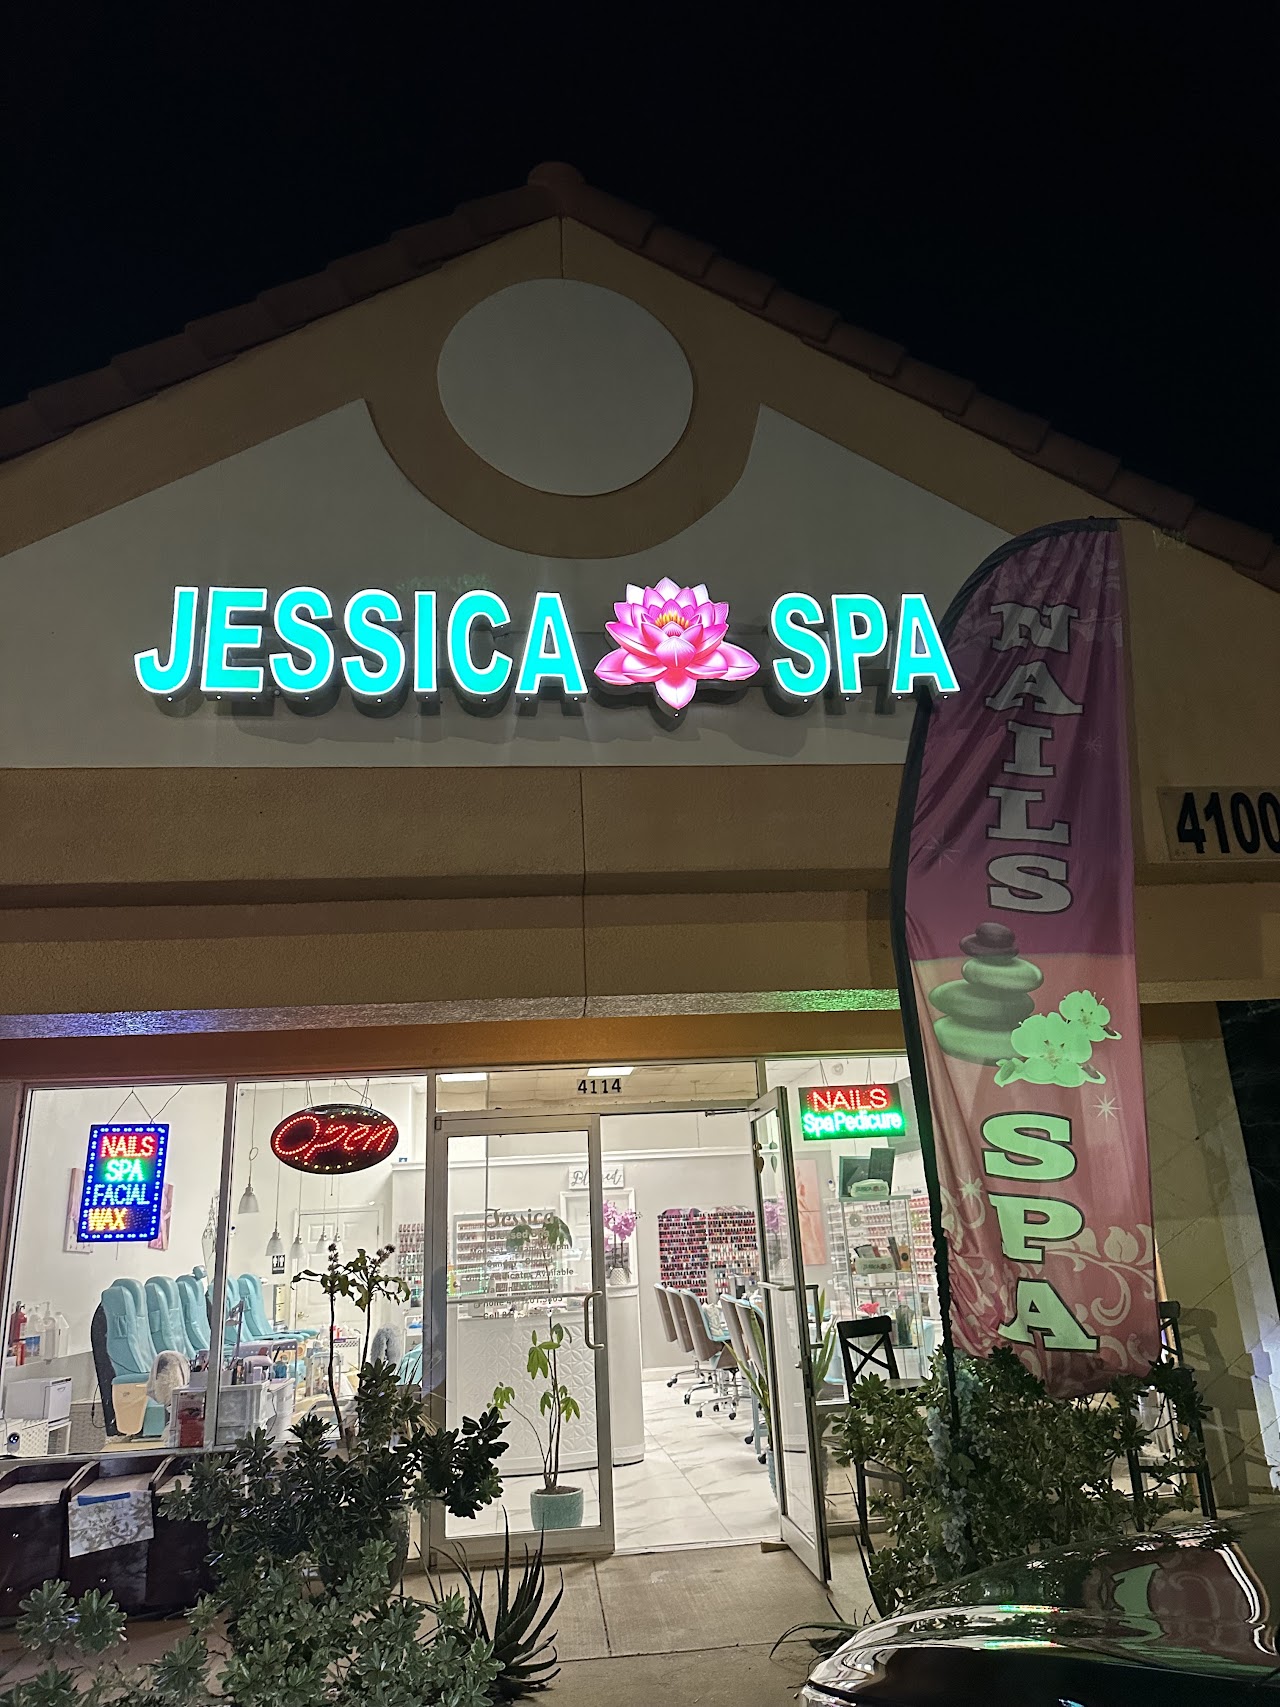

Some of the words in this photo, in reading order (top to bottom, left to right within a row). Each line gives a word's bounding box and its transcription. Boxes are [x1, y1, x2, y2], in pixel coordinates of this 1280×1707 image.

[133, 586, 588, 697] JESSICA
[770, 592, 961, 697] SPA
[985, 601, 1084, 914] NAILS
[1177, 792, 1280, 854] 4100
[577, 1078, 621, 1094] 4114
[811, 1088, 888, 1113] NAILS
[803, 1113, 834, 1137] Spa
[833, 1110, 902, 1131] Pedicure
[101, 1135, 155, 1157] NAILS
[275, 1115, 395, 1159] Open
[104, 1158, 145, 1182] SPA
[92, 1184, 150, 1205] FACIAL
[88, 1208, 127, 1231] WAX
[484, 1208, 554, 1229] Jessica
[981, 1110, 1100, 1352] SPA
[536, 1267, 574, 1278] Available
